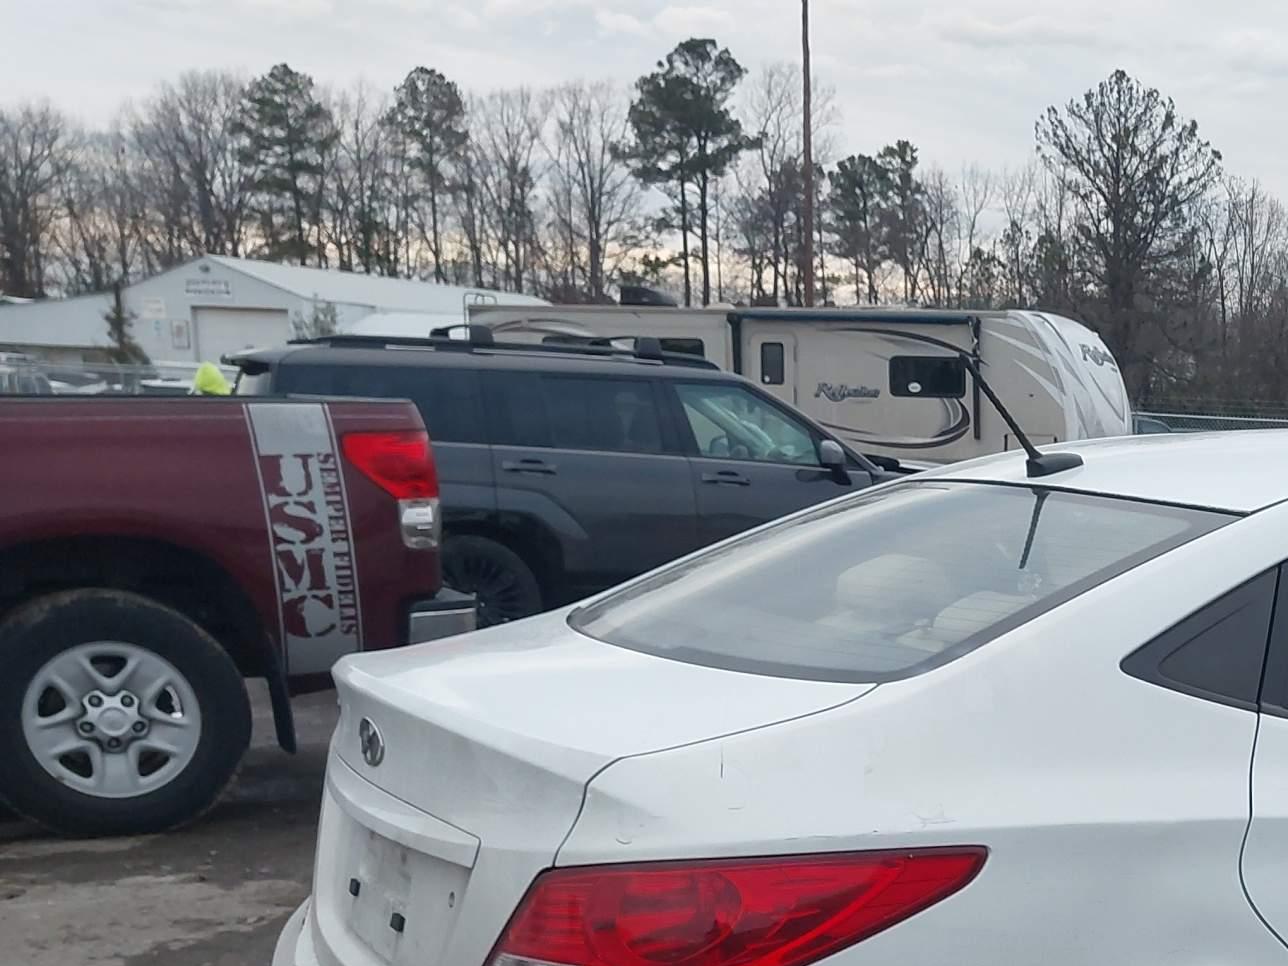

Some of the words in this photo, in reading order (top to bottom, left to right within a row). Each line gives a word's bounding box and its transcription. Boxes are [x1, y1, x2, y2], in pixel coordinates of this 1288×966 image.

[317, 452, 348, 543] SEMPER
[258, 453, 337, 637] USMC
[332, 549, 358, 635] FIDELIS
